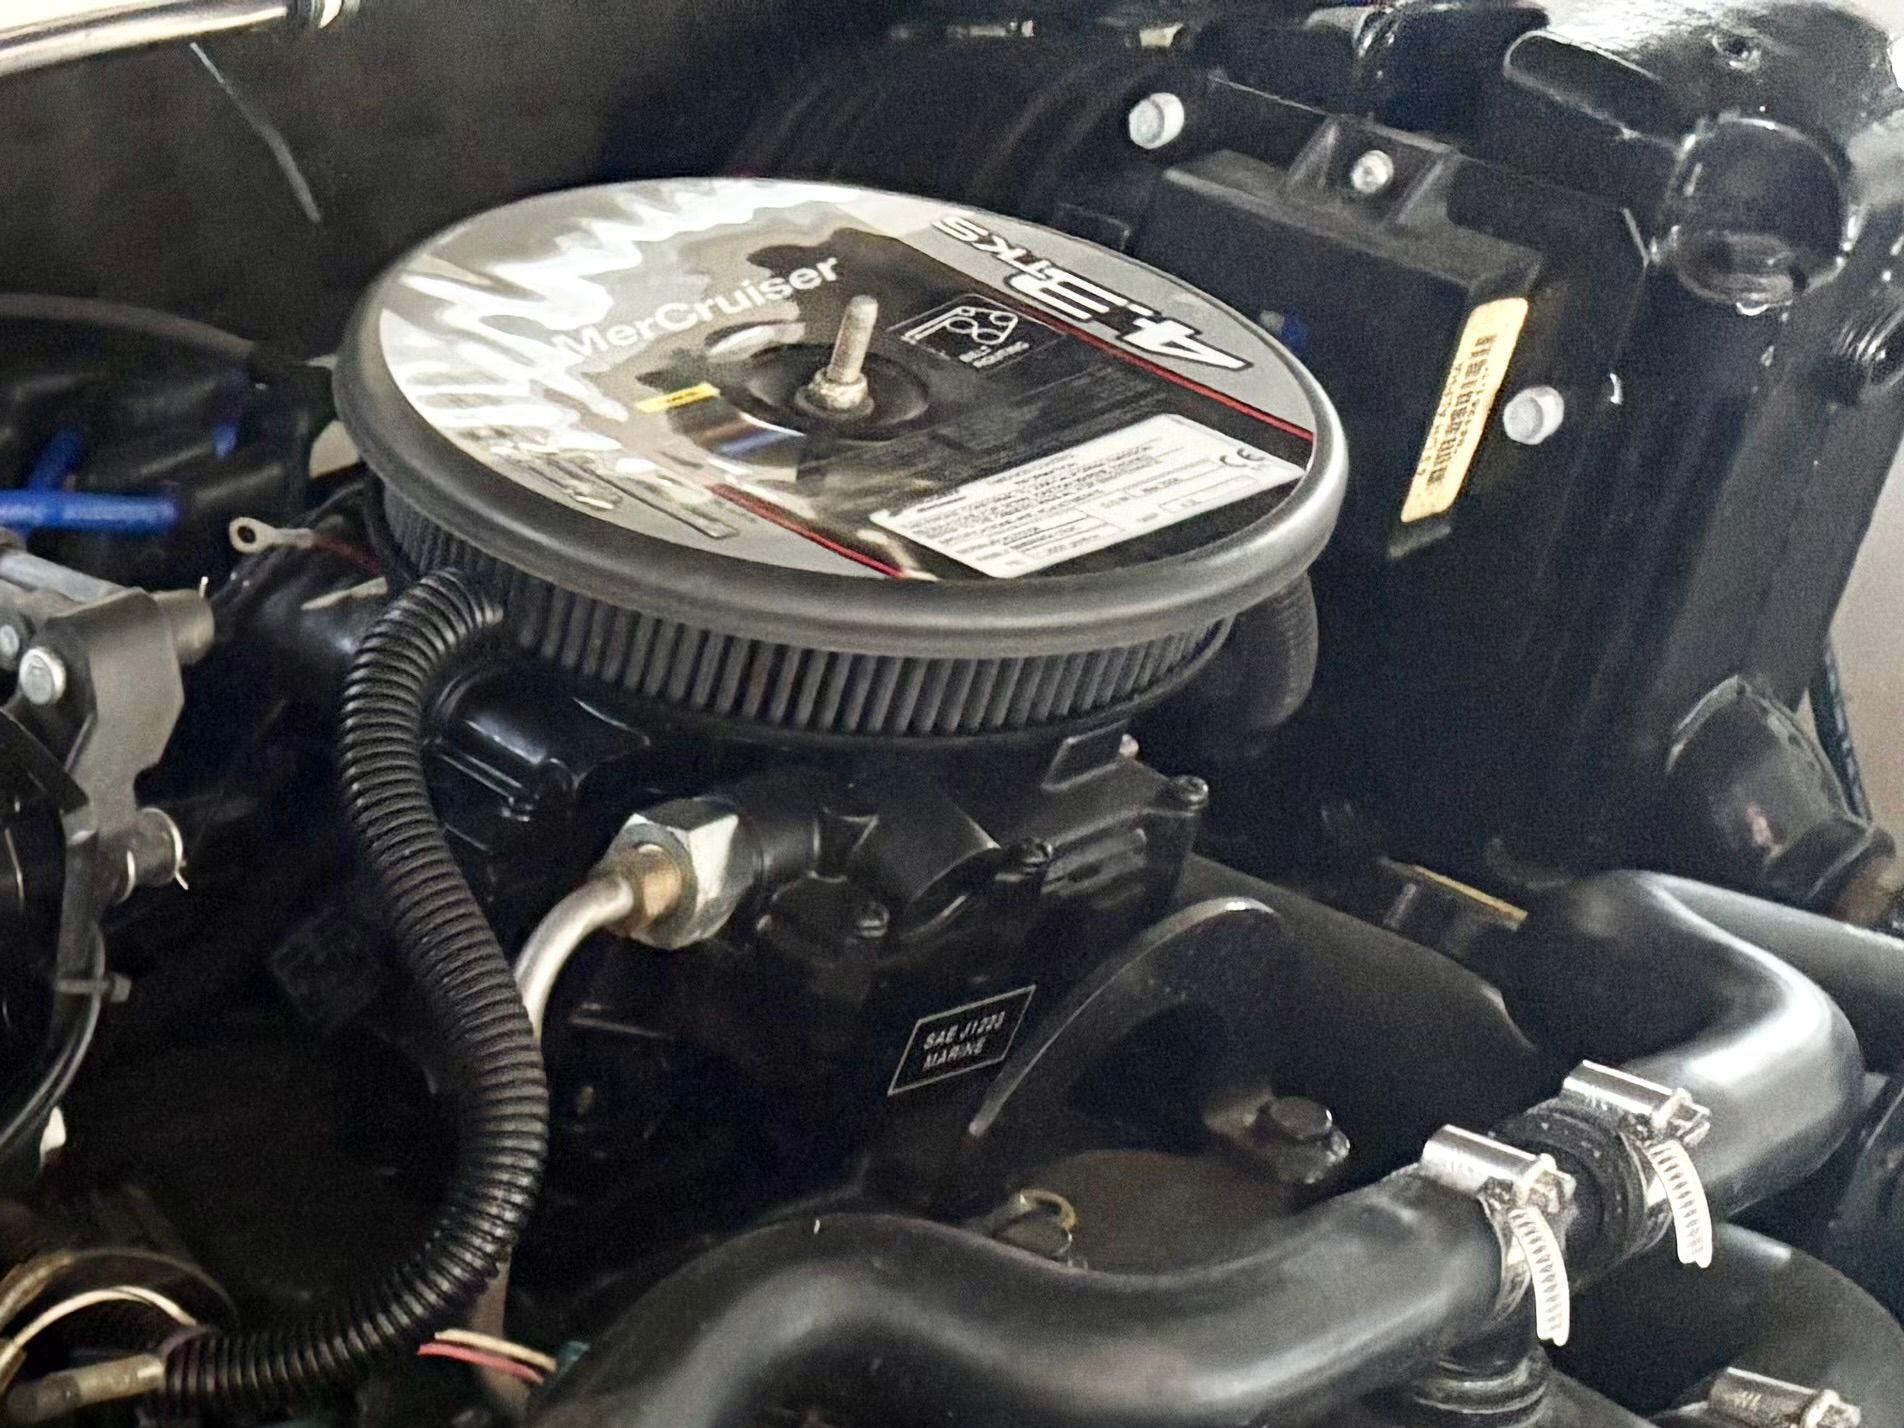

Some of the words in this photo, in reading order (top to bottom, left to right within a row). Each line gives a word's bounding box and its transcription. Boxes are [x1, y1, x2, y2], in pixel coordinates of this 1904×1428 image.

[550, 256, 839, 355] MerCruiser
[924, 1024, 959, 1049] SAE
[923, 1037, 986, 1071] MARINE
